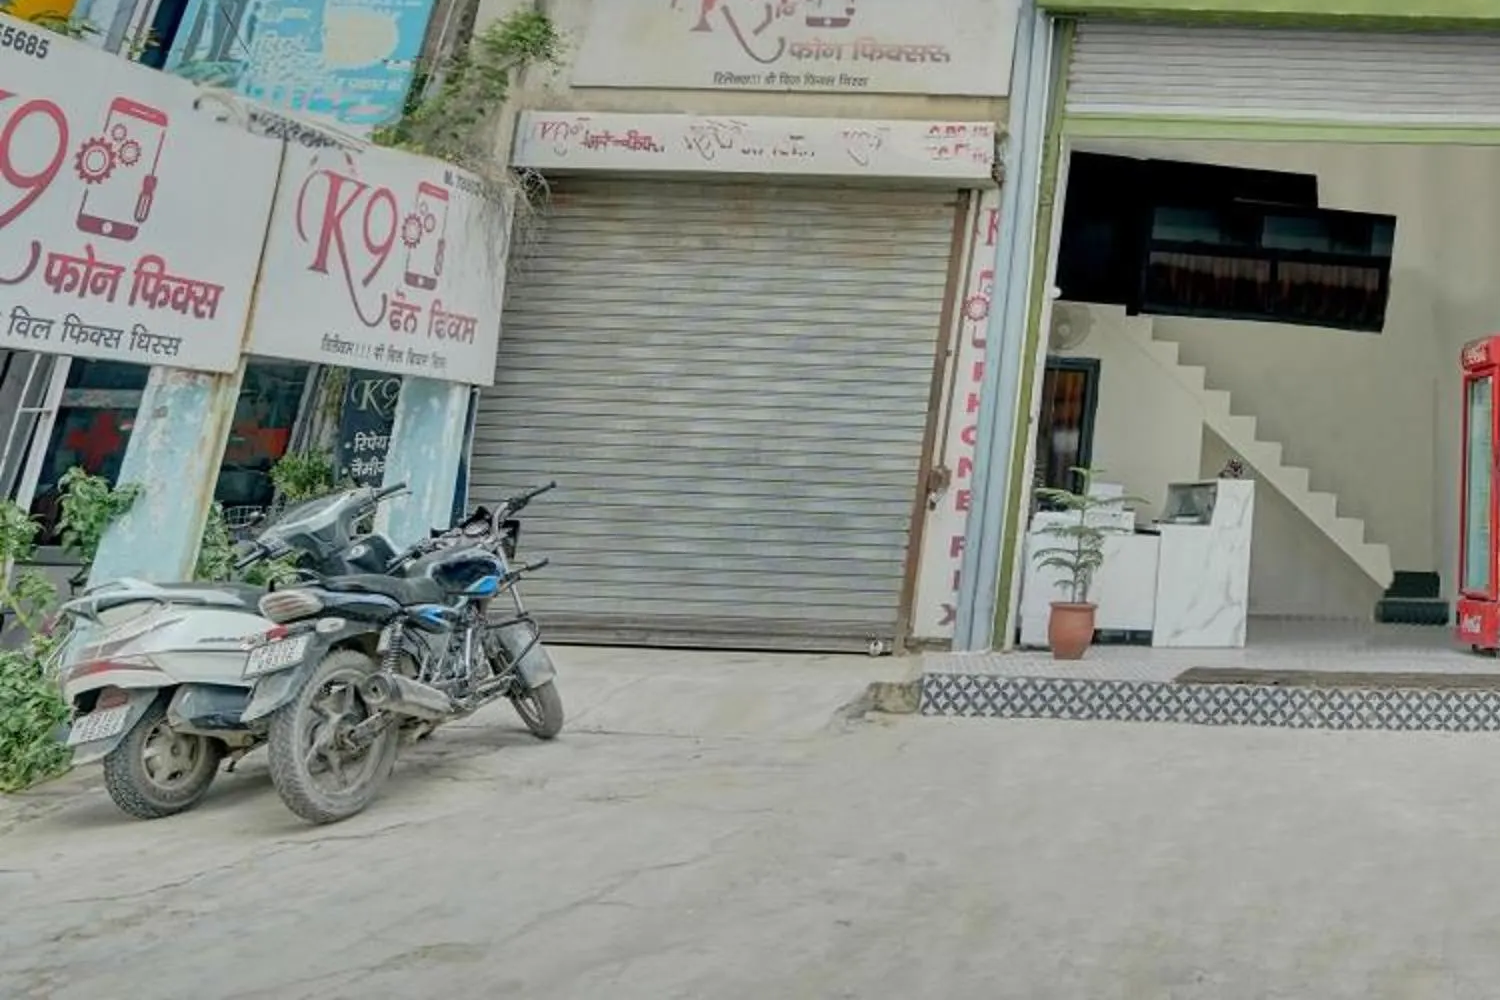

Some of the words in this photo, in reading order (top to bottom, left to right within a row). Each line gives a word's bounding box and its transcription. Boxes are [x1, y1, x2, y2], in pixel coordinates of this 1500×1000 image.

[299, 156, 398, 328] K9
[44, 243, 125, 303] फोन
[128, 254, 225, 320] फिक्स
[7, 305, 56, 342] विल
[61, 312, 124, 350] फिक्स
[351, 377, 401, 420] K9
